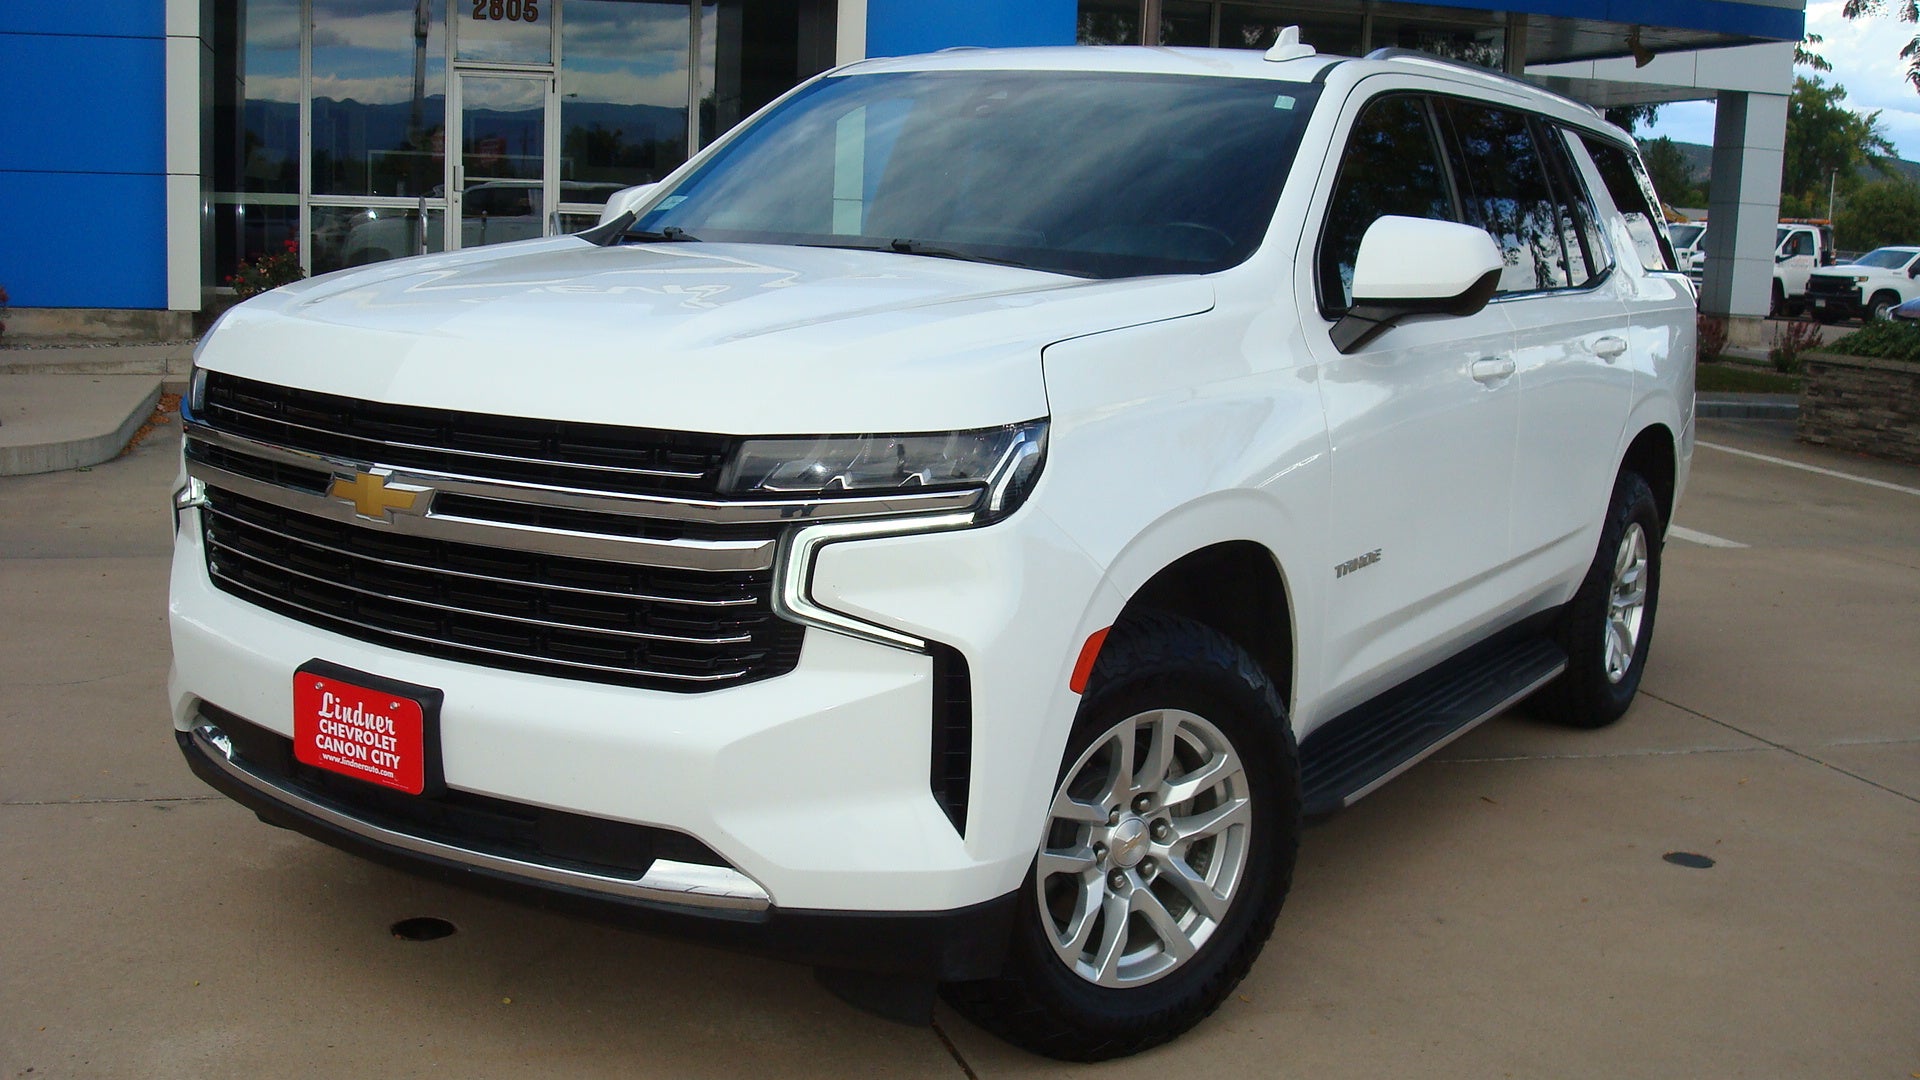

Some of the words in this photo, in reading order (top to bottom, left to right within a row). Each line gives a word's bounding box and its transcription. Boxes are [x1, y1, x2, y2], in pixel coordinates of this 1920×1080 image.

[473, 0, 539, 22] 2805
[1334, 548, 1382, 579] TAHOE
[318, 691, 395, 735] Lindner
[319, 719, 397, 752] CHEVROLET
[315, 734, 367, 761] CANON
[370, 749, 401, 770] CITY
[322, 753, 394, 778] www.lindnerauto.com
